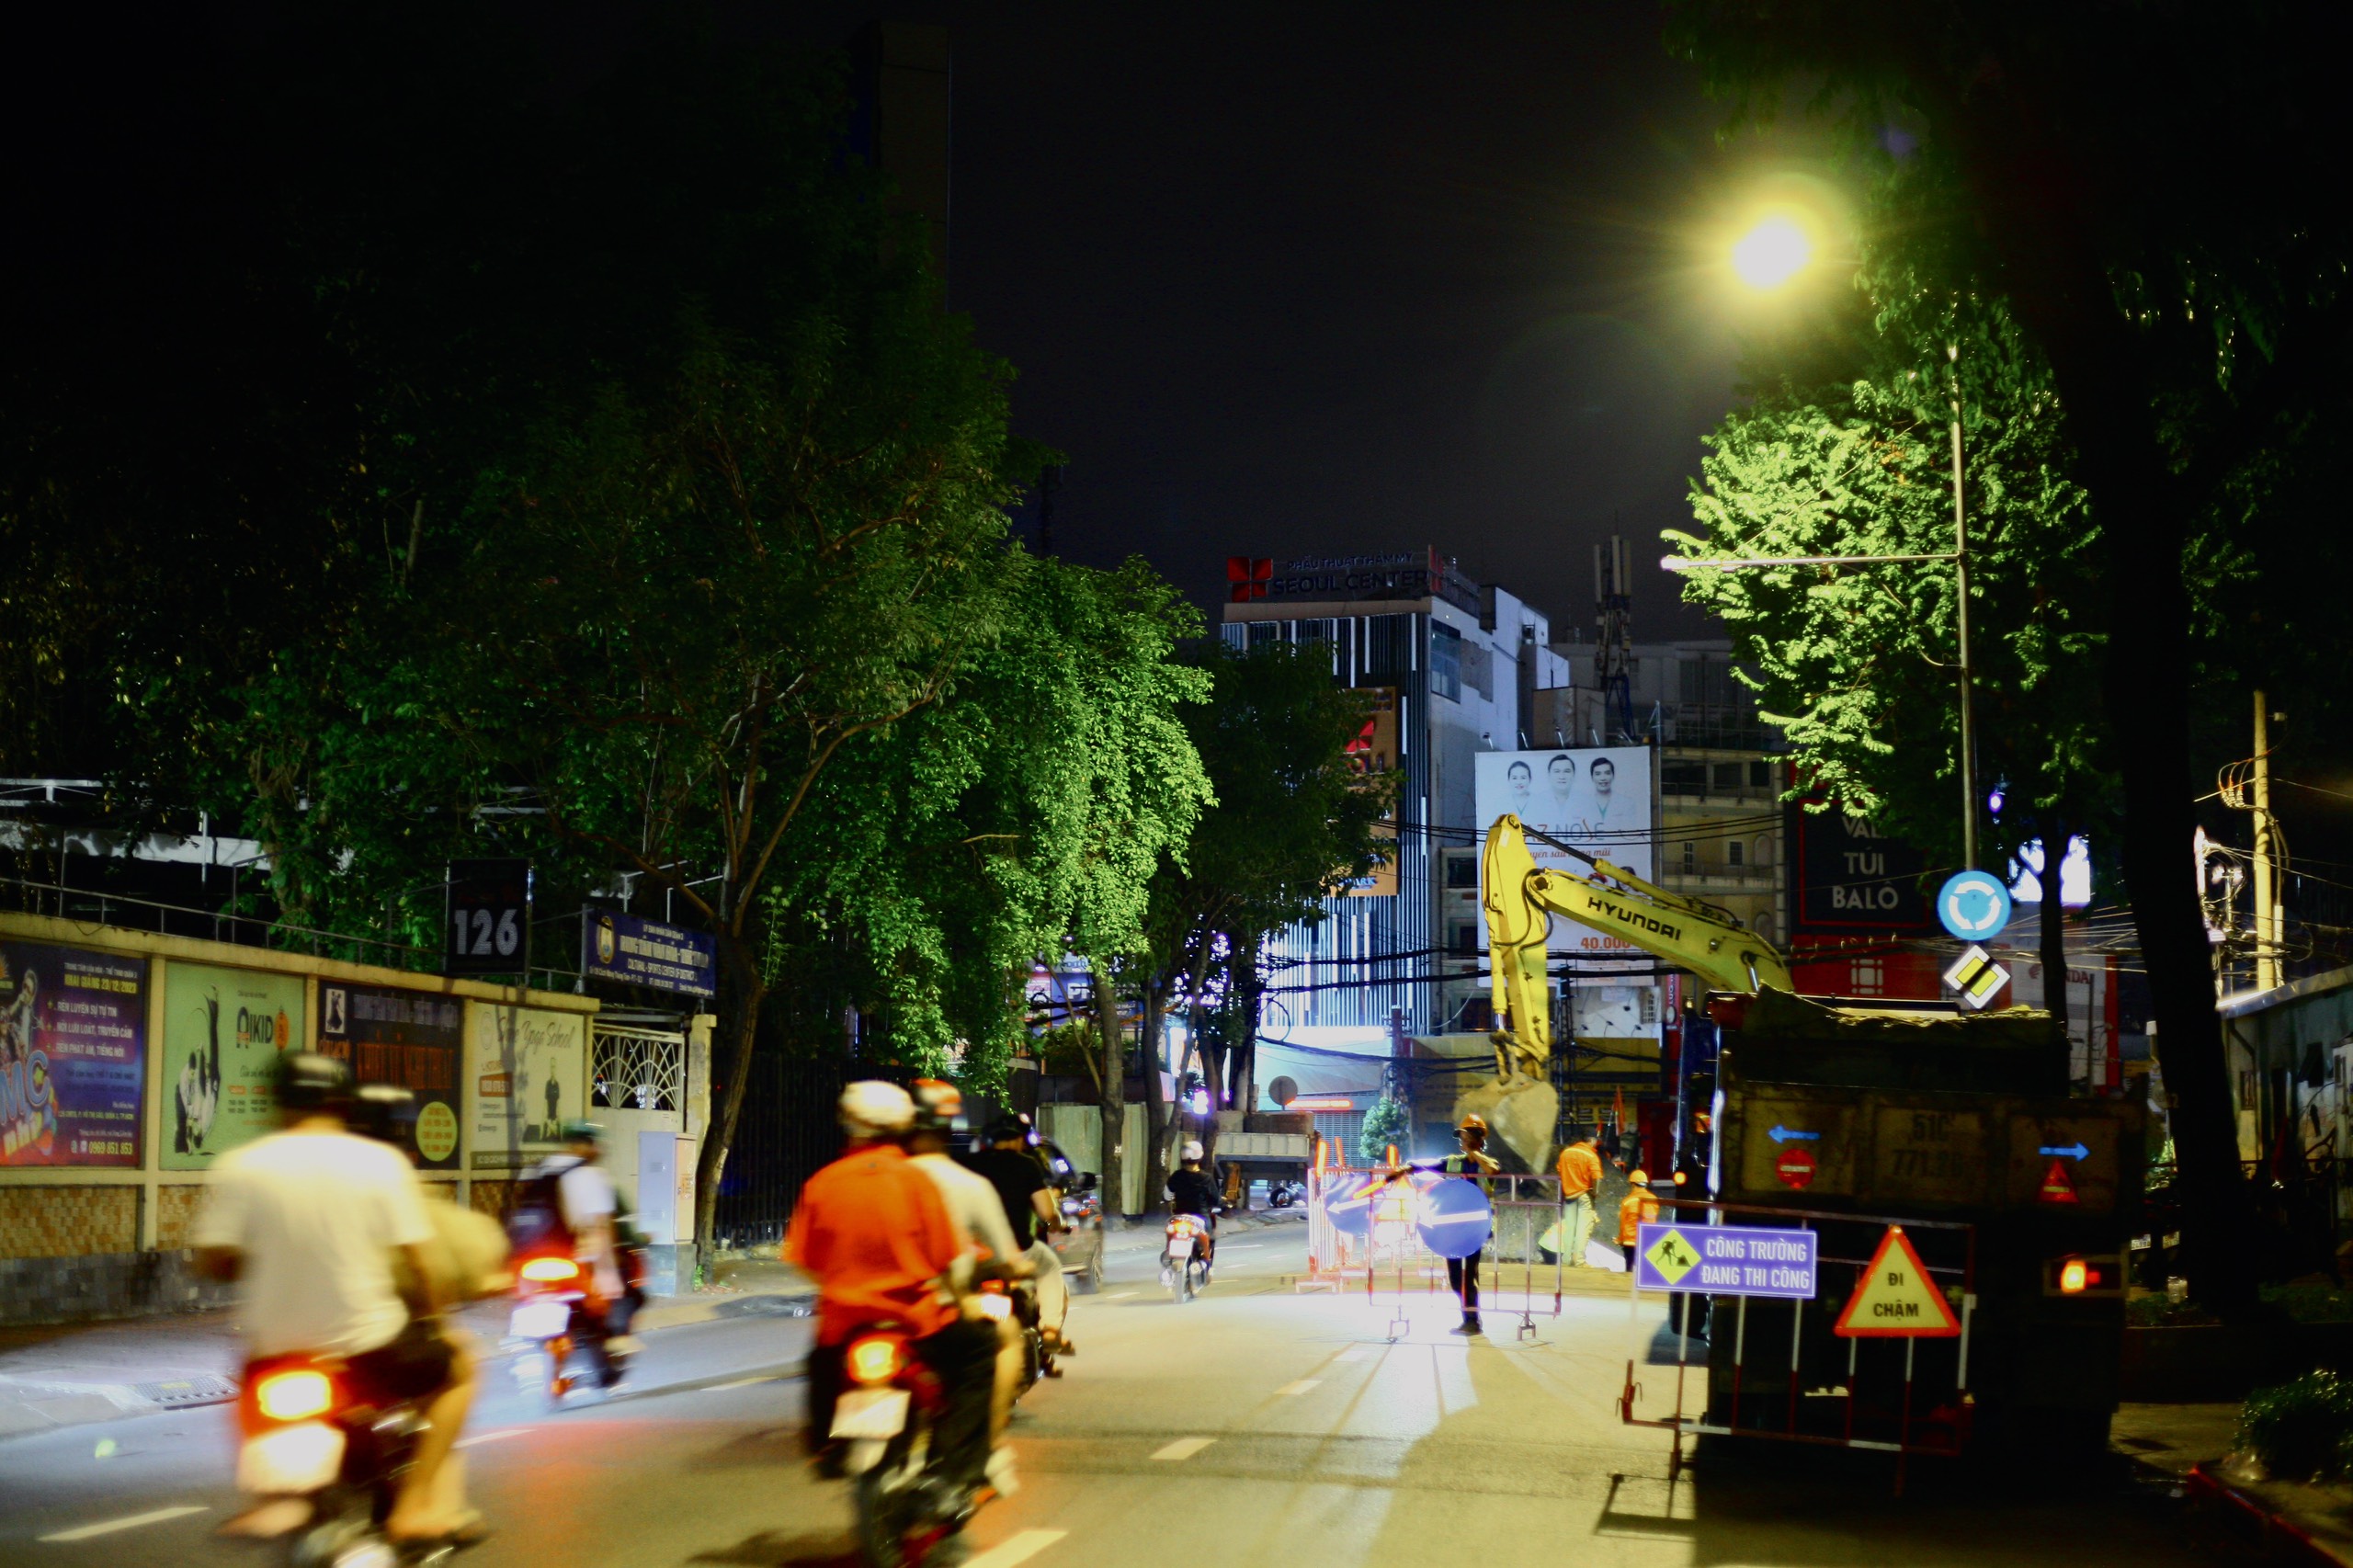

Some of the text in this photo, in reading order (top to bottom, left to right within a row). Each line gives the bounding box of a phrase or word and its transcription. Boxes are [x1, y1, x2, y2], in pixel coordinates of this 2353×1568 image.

[1272, 569, 1428, 596] SEOUL CENTER
[1555, 817, 1605, 843] NOSE
[1841, 814, 1888, 839] VAL
[1843, 846, 1884, 875] TÚI
[1831, 881, 1900, 910] BALÔ
[454, 908, 518, 956] 126
[1586, 896, 1682, 941] HYUNDAI
[1706, 1235, 1807, 1262] CÔNG TRƯỜNG
[1701, 1265, 1810, 1290] ĐANG THI CÔNG
[1887, 1272, 1904, 1287] ĐI
[1872, 1299, 1920, 1322] CHẬM
